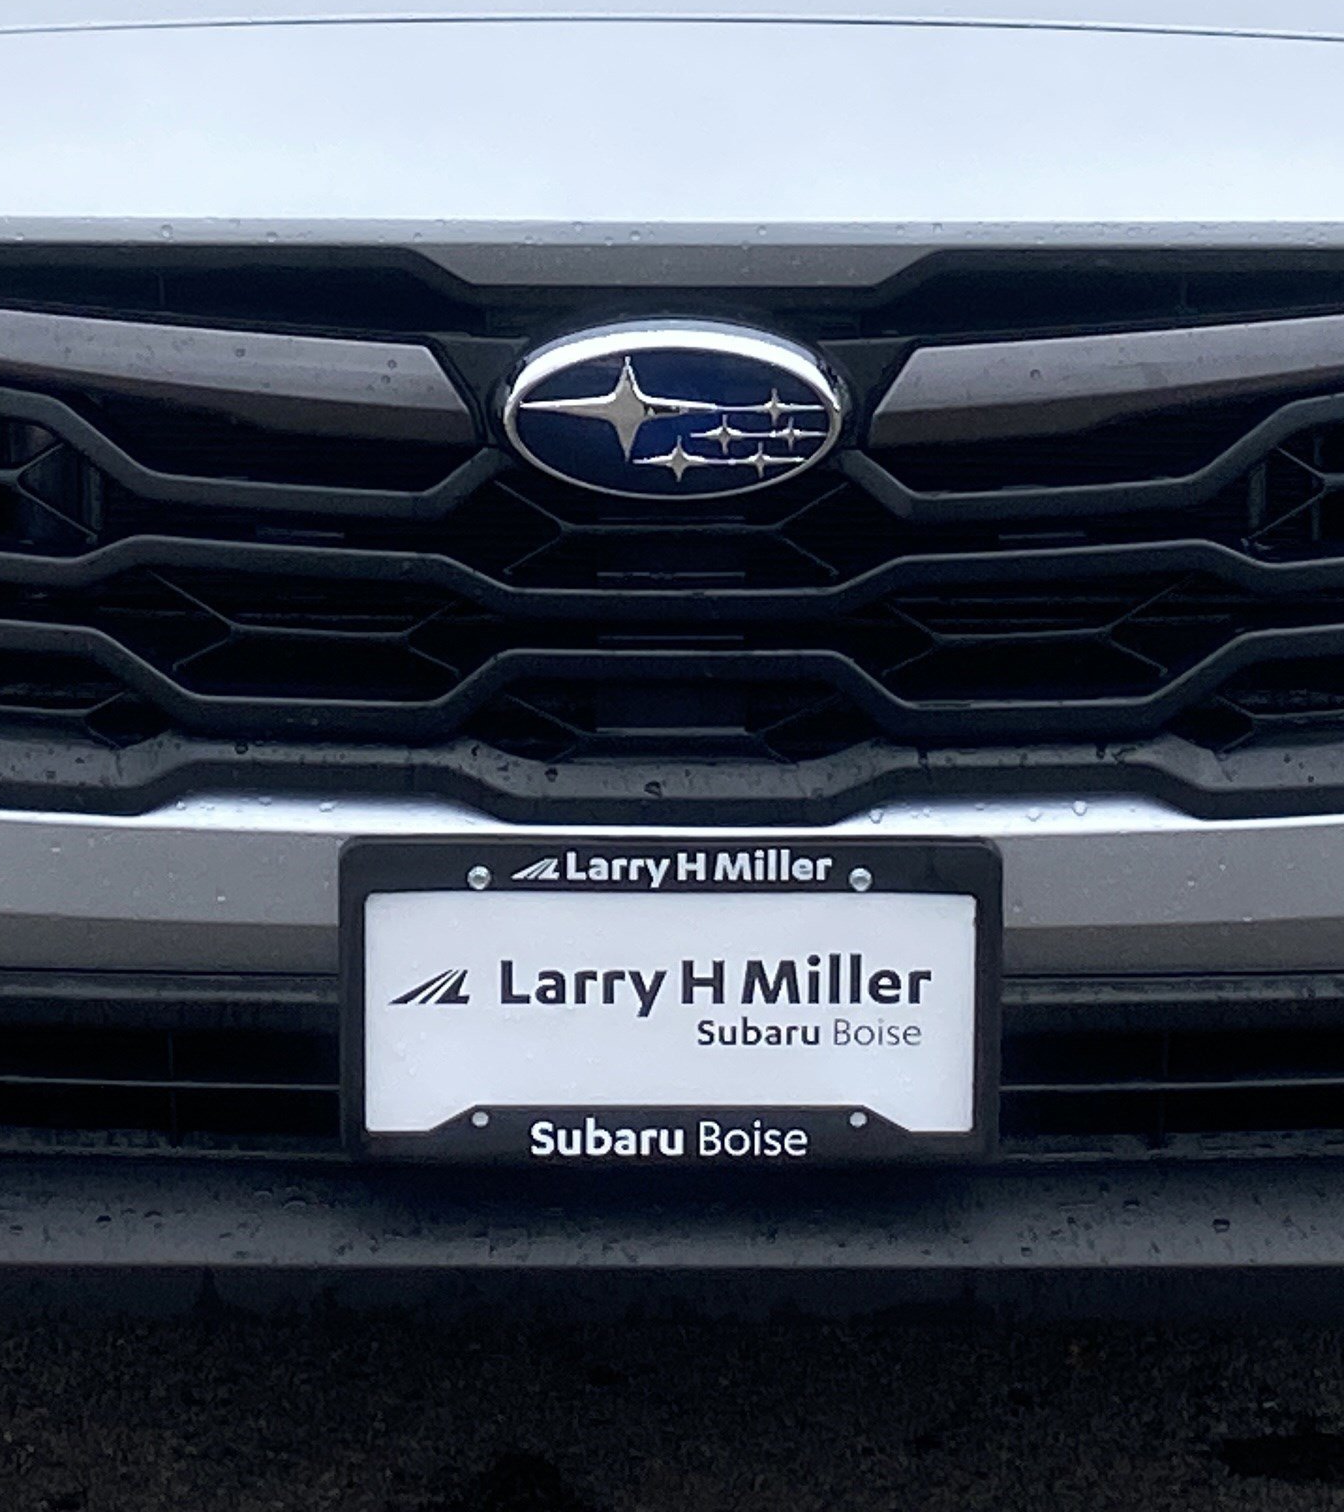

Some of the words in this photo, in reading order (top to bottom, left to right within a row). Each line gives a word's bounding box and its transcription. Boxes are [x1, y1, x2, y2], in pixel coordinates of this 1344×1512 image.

[566, 851, 671, 888] Larry
[677, 852, 706, 881] H
[713, 849, 833, 881] Miller
[500, 959, 667, 1018] Larry
[681, 959, 725, 1005] H
[740, 953, 932, 1005] Miller
[697, 1018, 821, 1046] Subaru
[833, 1018, 922, 1046] Boise
[530, 1119, 684, 1156] Subaru
[699, 1119, 808, 1156] Boise
